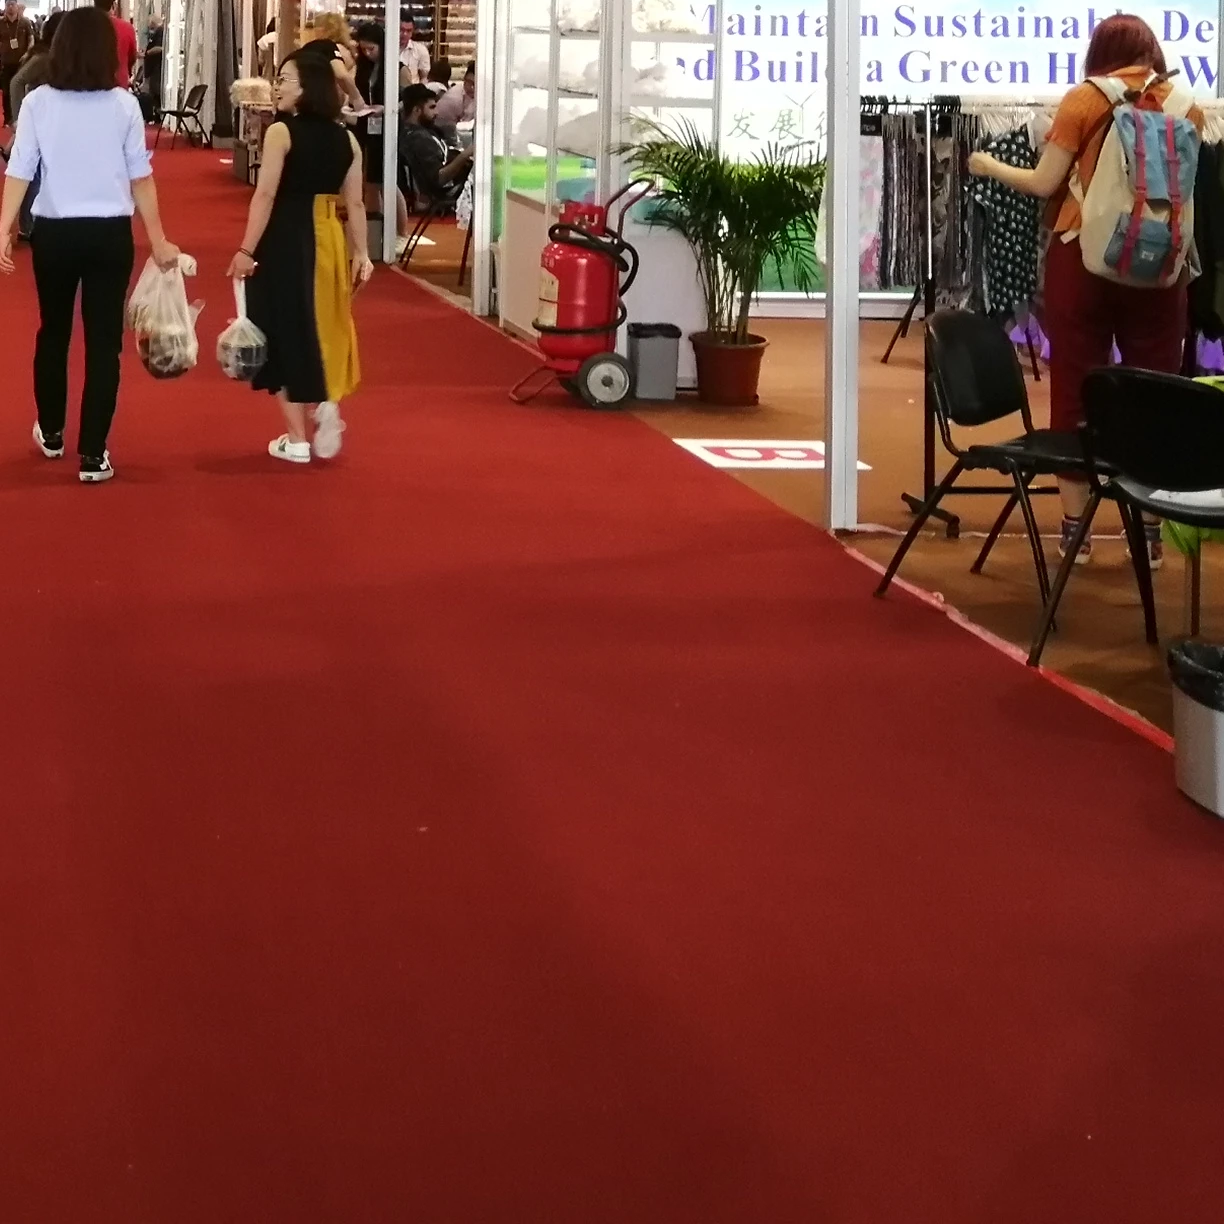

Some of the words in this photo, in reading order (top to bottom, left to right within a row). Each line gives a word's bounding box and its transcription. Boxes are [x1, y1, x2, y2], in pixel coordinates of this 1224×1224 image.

[690, 4, 879, 38] Maintan
[735, 50, 819, 83] Buil
[898, 49, 1030, 84] Green
